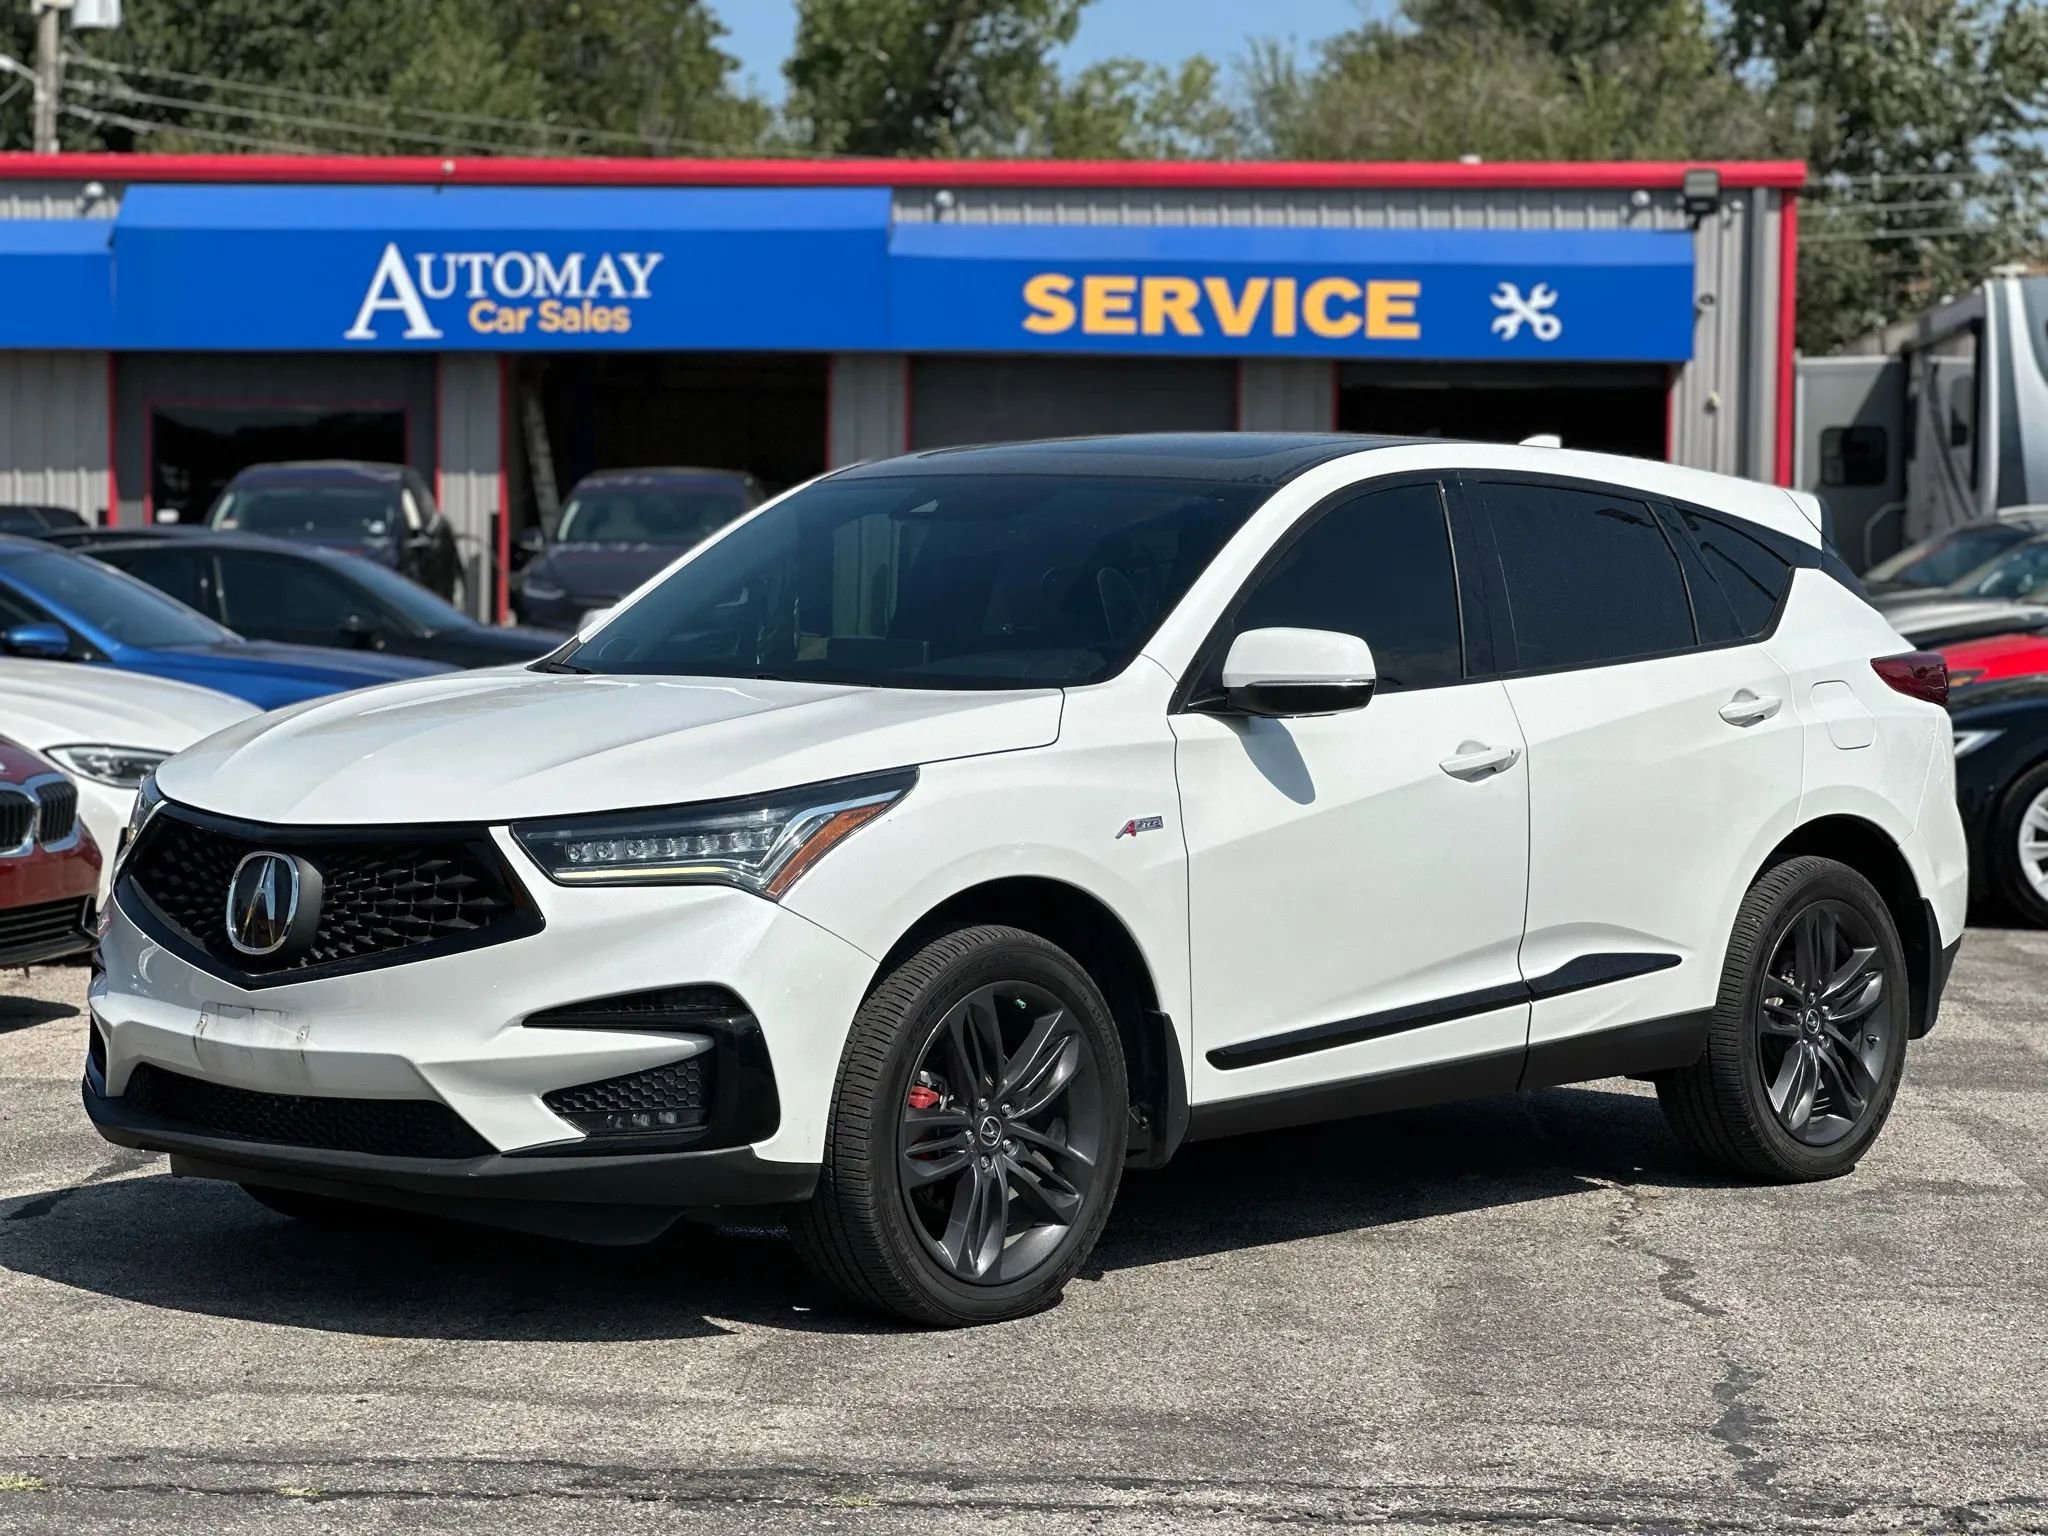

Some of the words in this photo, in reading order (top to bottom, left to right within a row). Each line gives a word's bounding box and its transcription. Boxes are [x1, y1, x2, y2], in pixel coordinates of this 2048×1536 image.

[343, 242, 664, 340] AUTOMAY
[468, 300, 532, 334] Car
[537, 300, 631, 334] Sales
[1022, 274, 1421, 340] SERVICE
